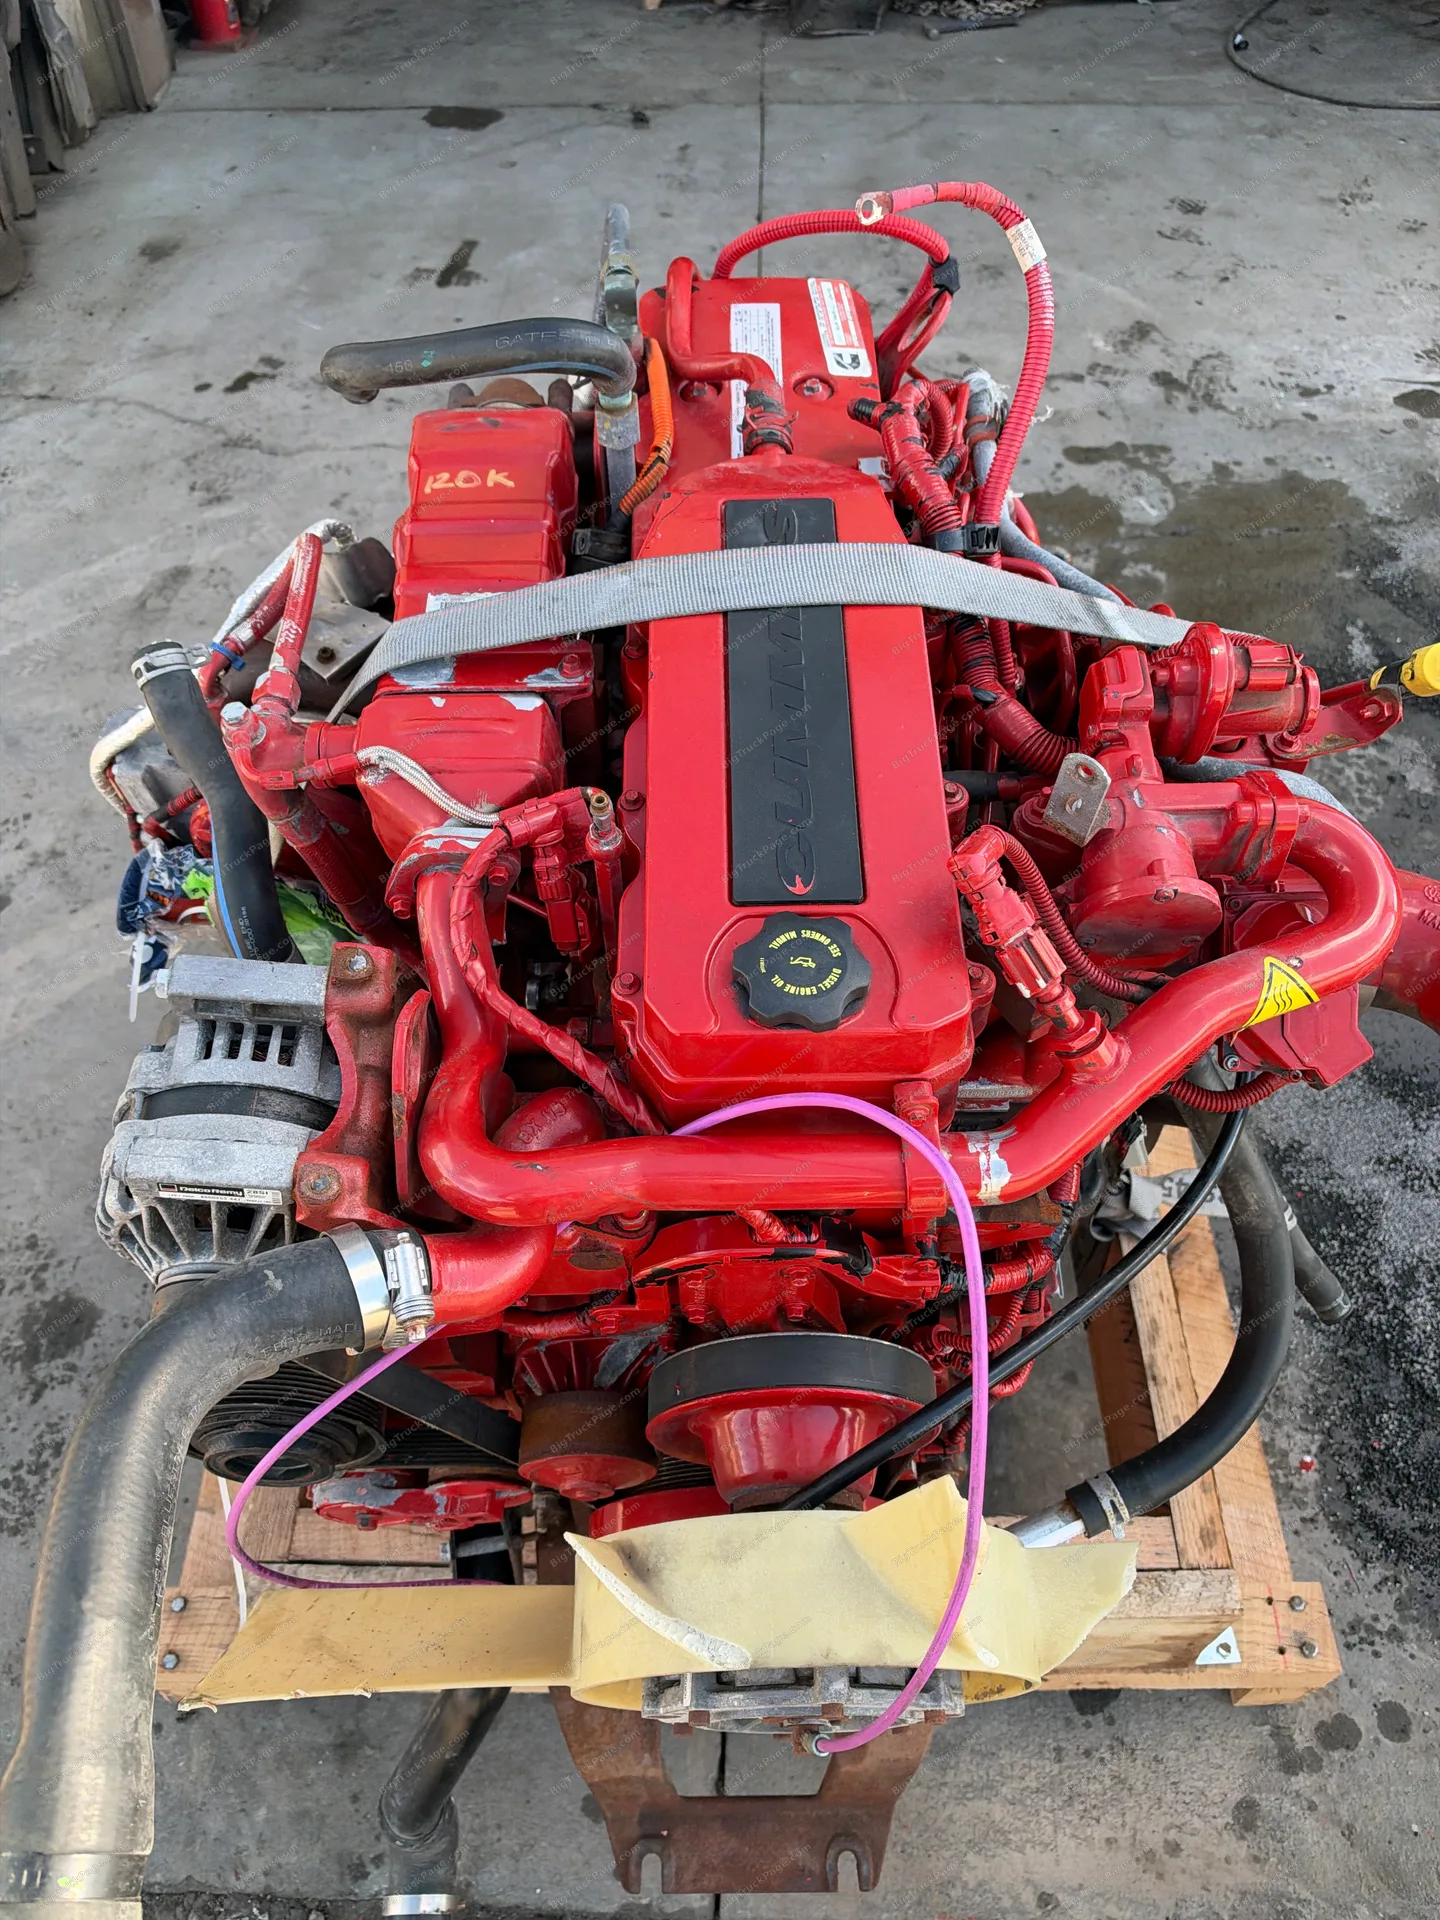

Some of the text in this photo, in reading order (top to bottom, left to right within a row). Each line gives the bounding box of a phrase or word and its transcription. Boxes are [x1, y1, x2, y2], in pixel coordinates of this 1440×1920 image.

[1418, 909, 1440, 931] MA
[768, 929, 842, 958] SEE OWNERS MANUAL
[770, 968, 842, 996] DIESEL ENGINE OIL
